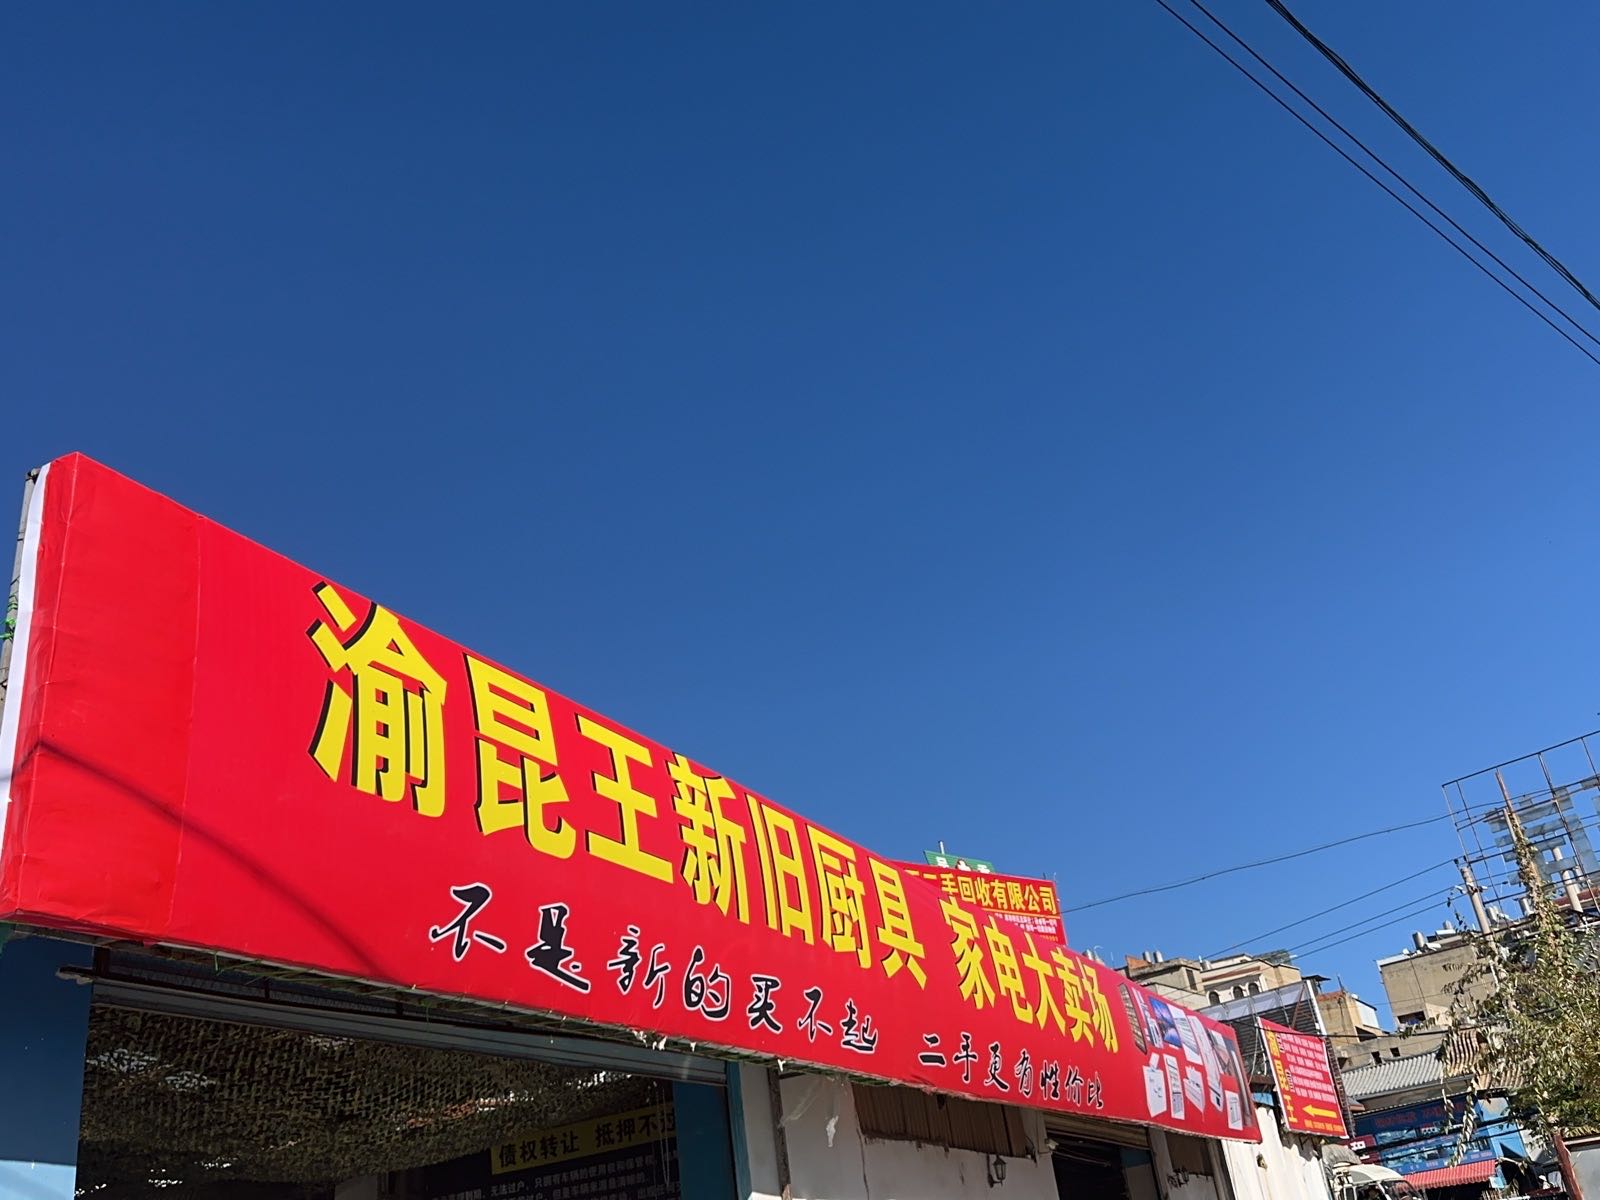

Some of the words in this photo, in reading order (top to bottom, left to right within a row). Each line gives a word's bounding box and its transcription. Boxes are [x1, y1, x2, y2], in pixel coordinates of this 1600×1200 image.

[904, 869, 1058, 915] 手回收有限公司
[429, 882, 878, 1054] 不是新的买不起
[918, 1032, 1104, 1108] 二手更有性价比
[938, 895, 1119, 1053] 家电大卖场
